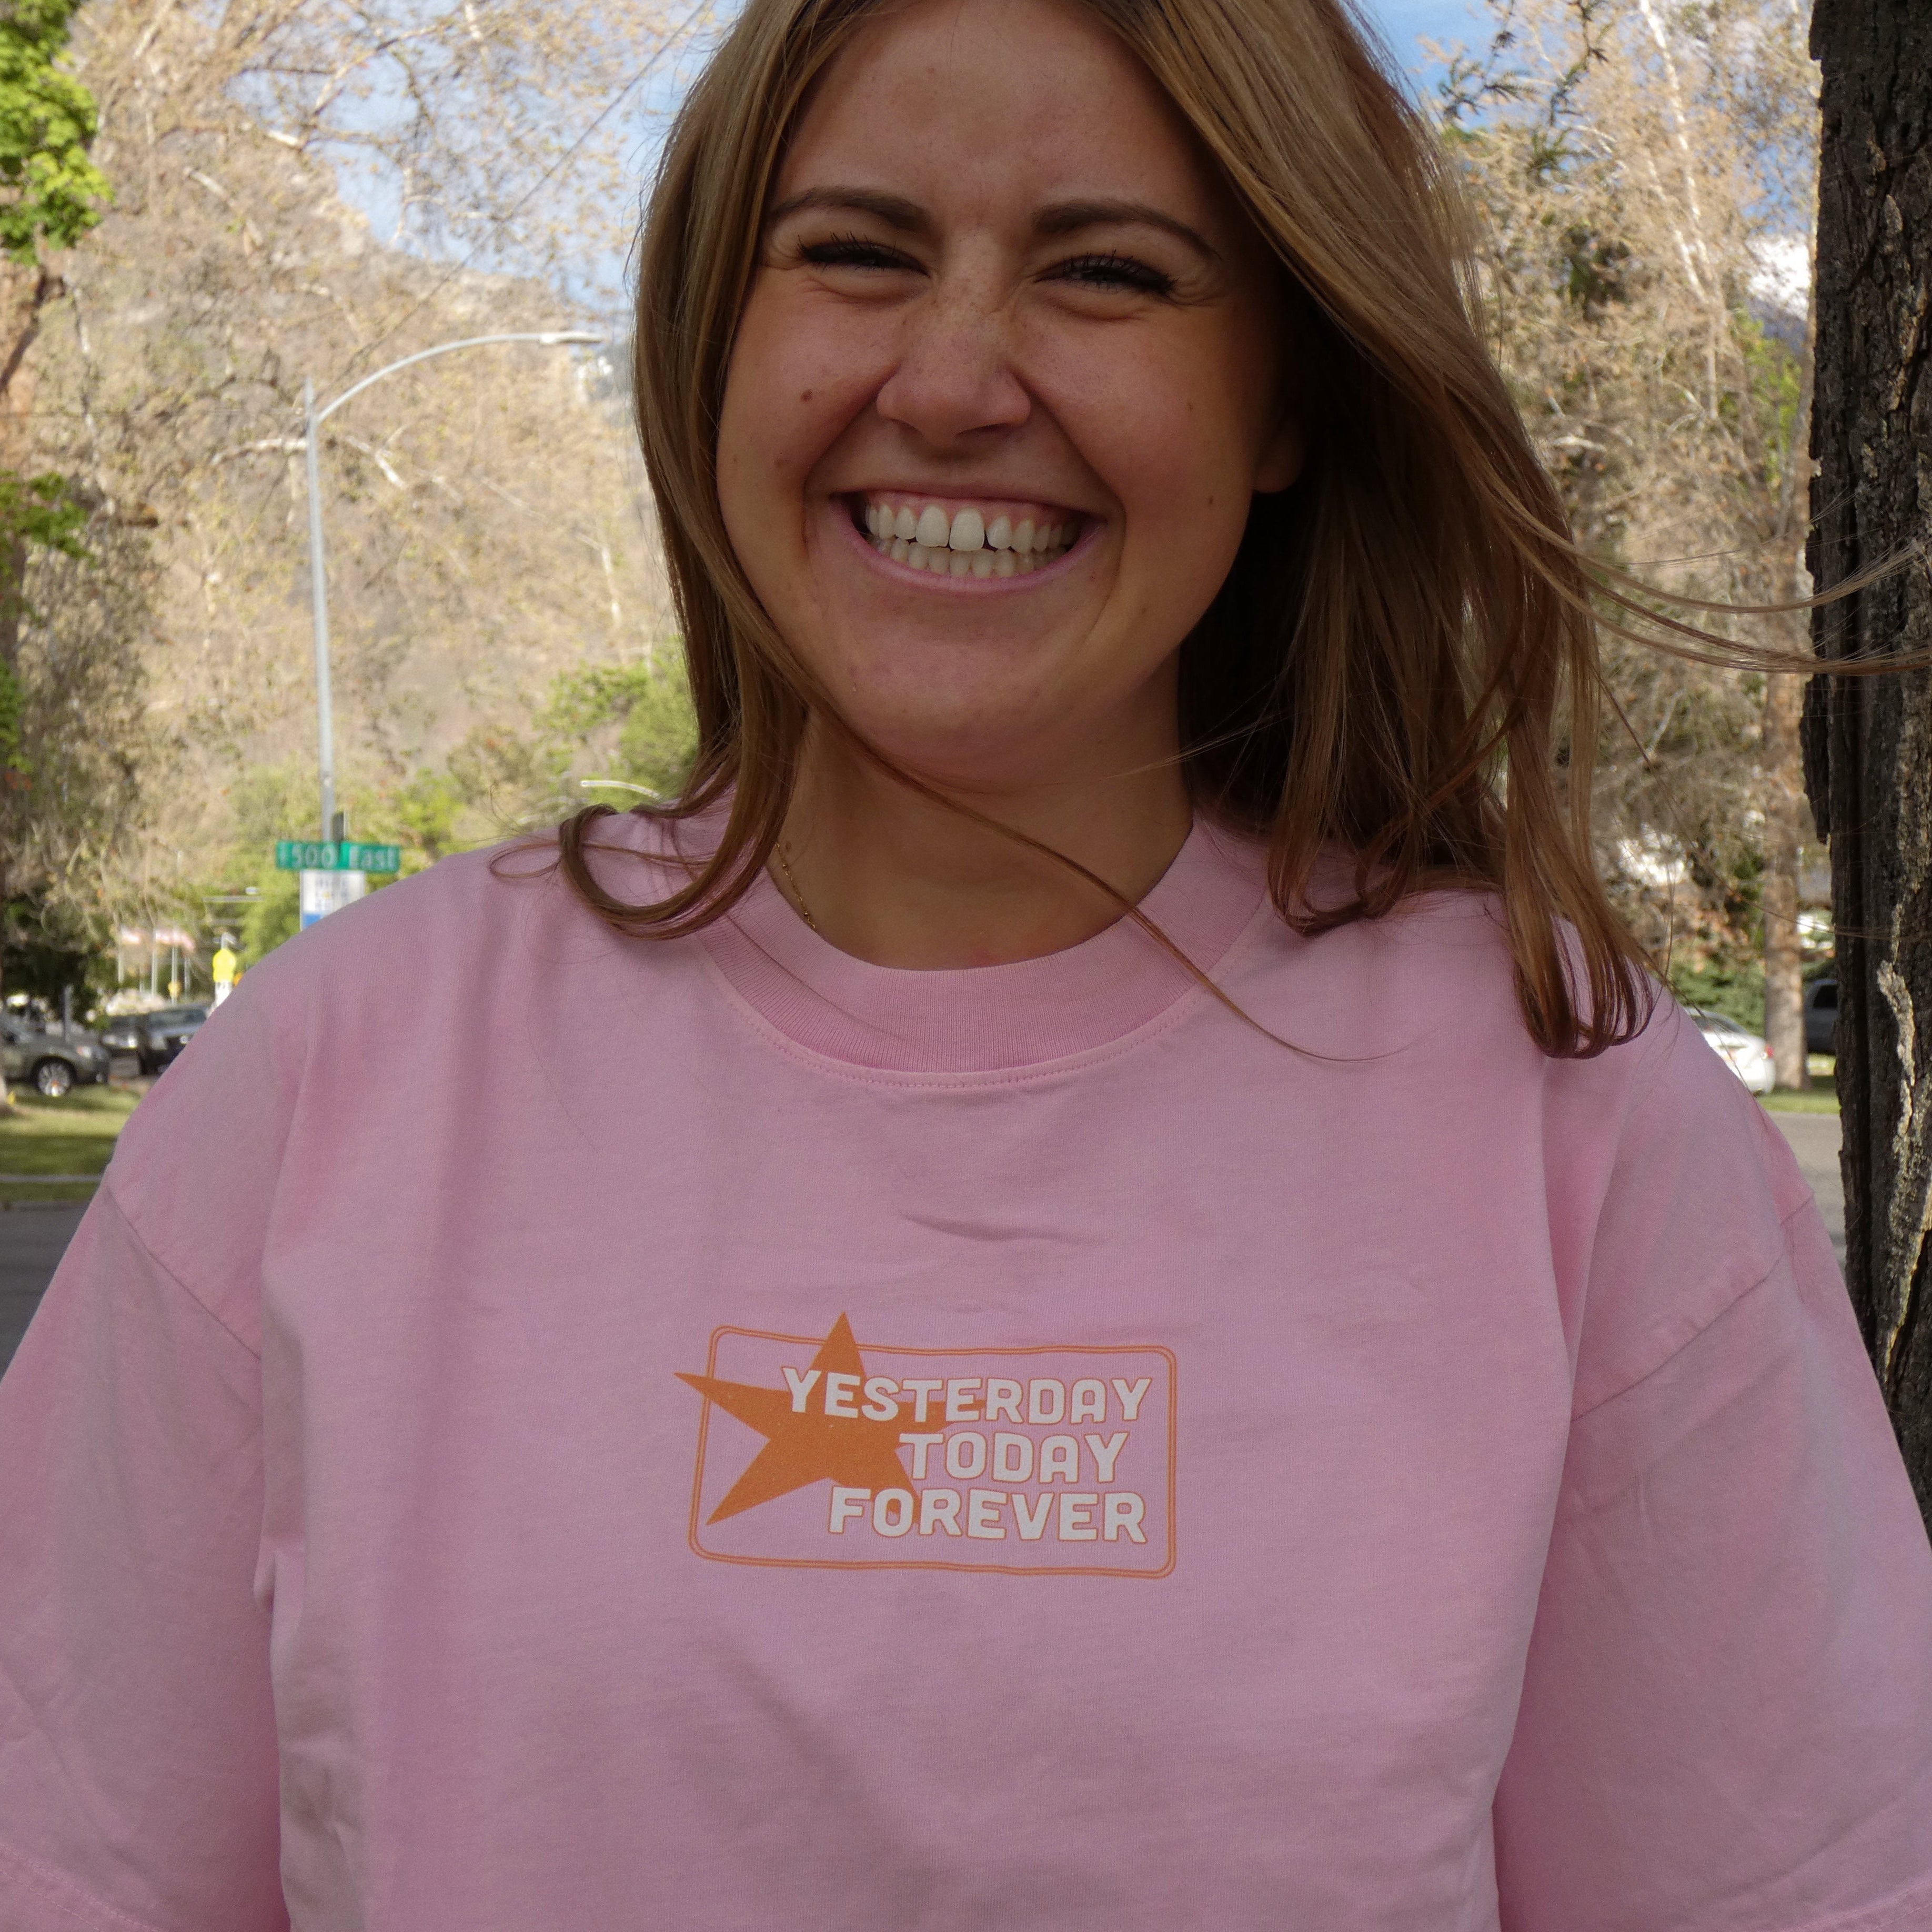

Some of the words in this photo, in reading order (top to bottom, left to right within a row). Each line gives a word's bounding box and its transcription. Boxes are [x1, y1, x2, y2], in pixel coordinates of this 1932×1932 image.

[781, 1367, 1152, 1424] YESTERDAY
[899, 1432, 1128, 1484] TODAY
[828, 1485, 1148, 1544] FOREVER
